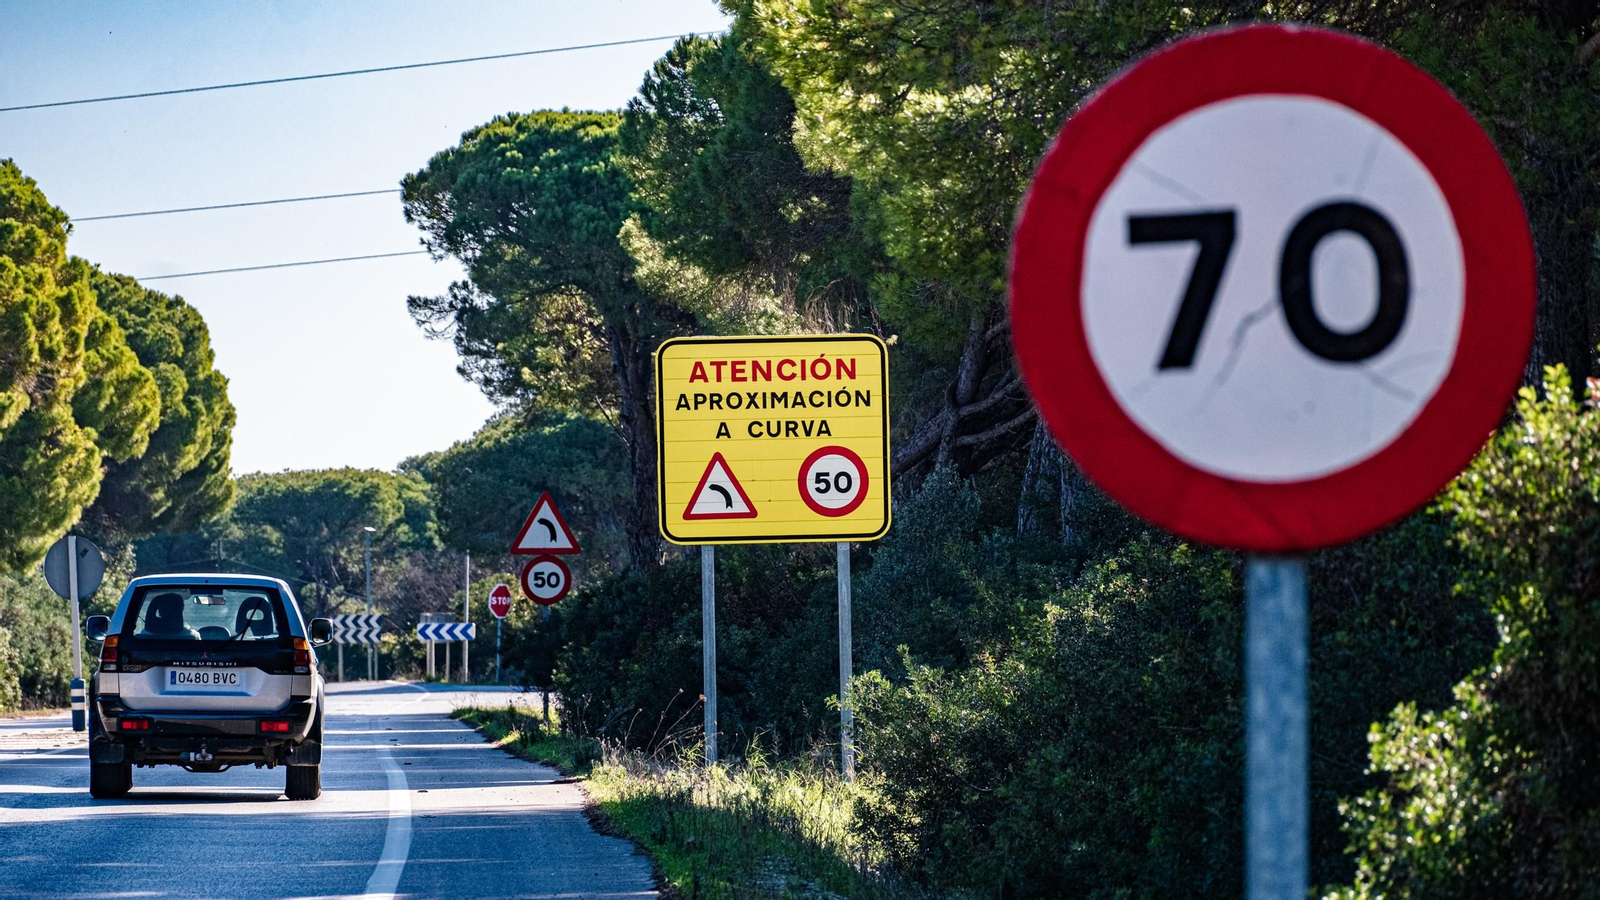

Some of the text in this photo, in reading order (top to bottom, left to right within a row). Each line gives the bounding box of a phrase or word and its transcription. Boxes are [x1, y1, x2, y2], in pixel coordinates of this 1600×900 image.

[1126, 201, 1411, 371] 70
[689, 353, 857, 383] ATENCIÓN
[675, 386, 871, 411] APROXIMACIÓN
[715, 420, 832, 439] A CURVA
[814, 471, 853, 494] 50
[533, 572, 560, 588] 50
[491, 596, 511, 605] STOP
[178, 672, 209, 684] 0480
[213, 672, 237, 684] BVC
